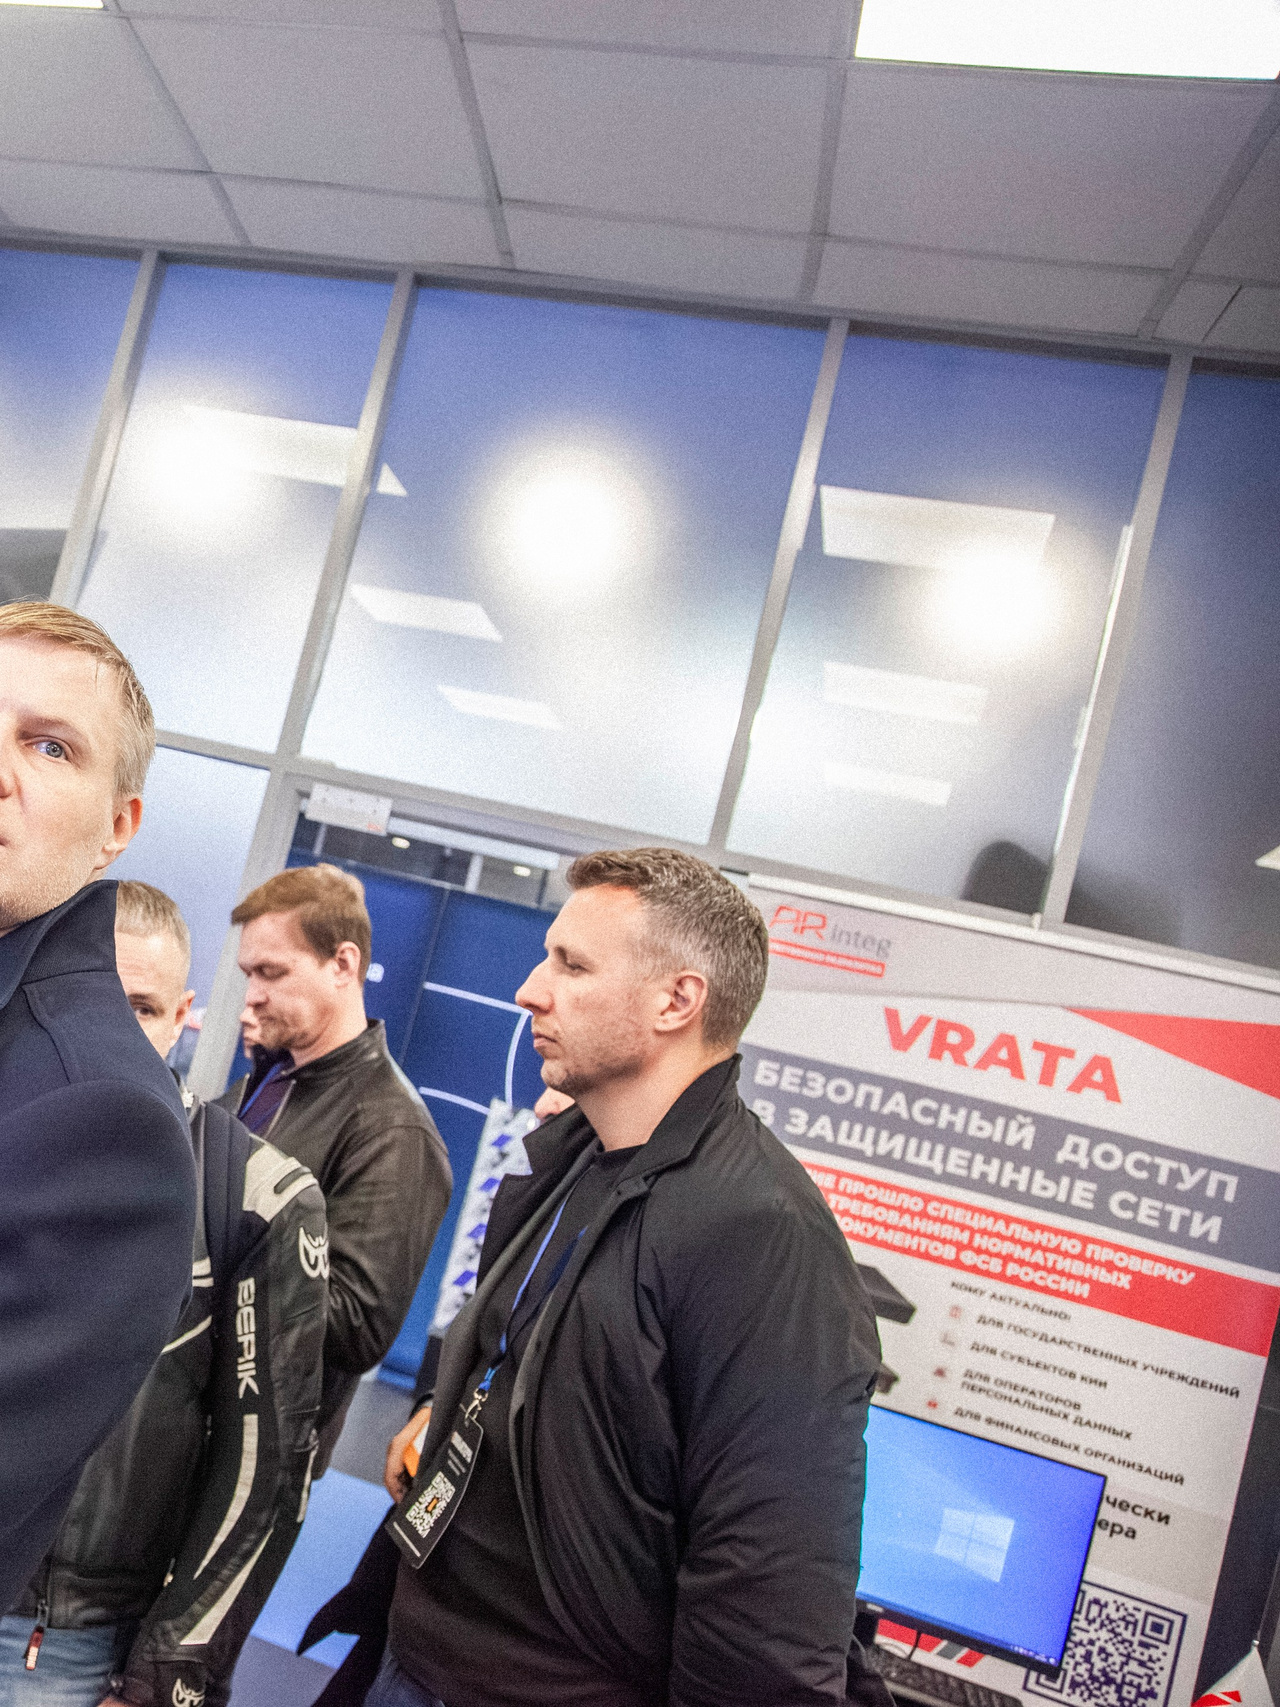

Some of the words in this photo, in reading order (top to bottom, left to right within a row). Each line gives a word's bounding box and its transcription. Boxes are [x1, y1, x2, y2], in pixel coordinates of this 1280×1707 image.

[884, 1006, 1122, 1104] VRATA
[752, 1098, 777, 1127] В
[784, 1106, 1098, 1210] ЗАЩИЩЕННЫЕ
[1108, 1190, 1223, 1244] СЕТИ
[754, 1059, 1037, 1150] БЕЗОПАСНЫЙ
[1056, 1132, 1240, 1203] ДОСТУП
[829, 1193, 970, 1245] ТРЕБОВАНИЯМ
[972, 1233, 1133, 1290] НОРМАТИВНЫХ
[838, 1176, 925, 1212] ПРОШЛО
[926, 1201, 1083, 1256] СПЕЦИАЛЬНУЮ
[1085, 1243, 1196, 1286] ПРОВЕРКУ
[951, 1281, 986, 1298] КОМУ
[989, 1291, 1072, 1322] АКТУАЛЬНО:
[959, 1250, 1004, 1274] ФСБ
[1005, 1262, 1091, 1299] РОССИИ
[235, 1277, 260, 1399] BERIK
[970, 1341, 997, 1357] ДЛЯ
[1000, 1350, 1076, 1380] СУБЪЕКТОВ
[1080, 1373, 1108, 1389] КИИ
[977, 1313, 1004, 1331] ДЛЯ
[1007, 1322, 1139, 1371] ГОСУДАРСТВЕННЫХ
[1142, 1360, 1240, 1399] УЧРЕЖДЕНИЙ
[960, 1380, 1069, 1421] ПЕРСОНАЛЬНЫХ
[1072, 1414, 1133, 1441] ДАННЫХ
[963, 1368, 991, 1384] ДЛЯ
[993, 1377, 1082, 1412] ОПЕРАТОРОВ
[953, 1406, 982, 1422] ДЛЯ
[984, 1414, 1080, 1454] ФИНАНСОВЫХ
[1084, 1447, 1185, 1486] ОРГАНИЗАЦИЙ
